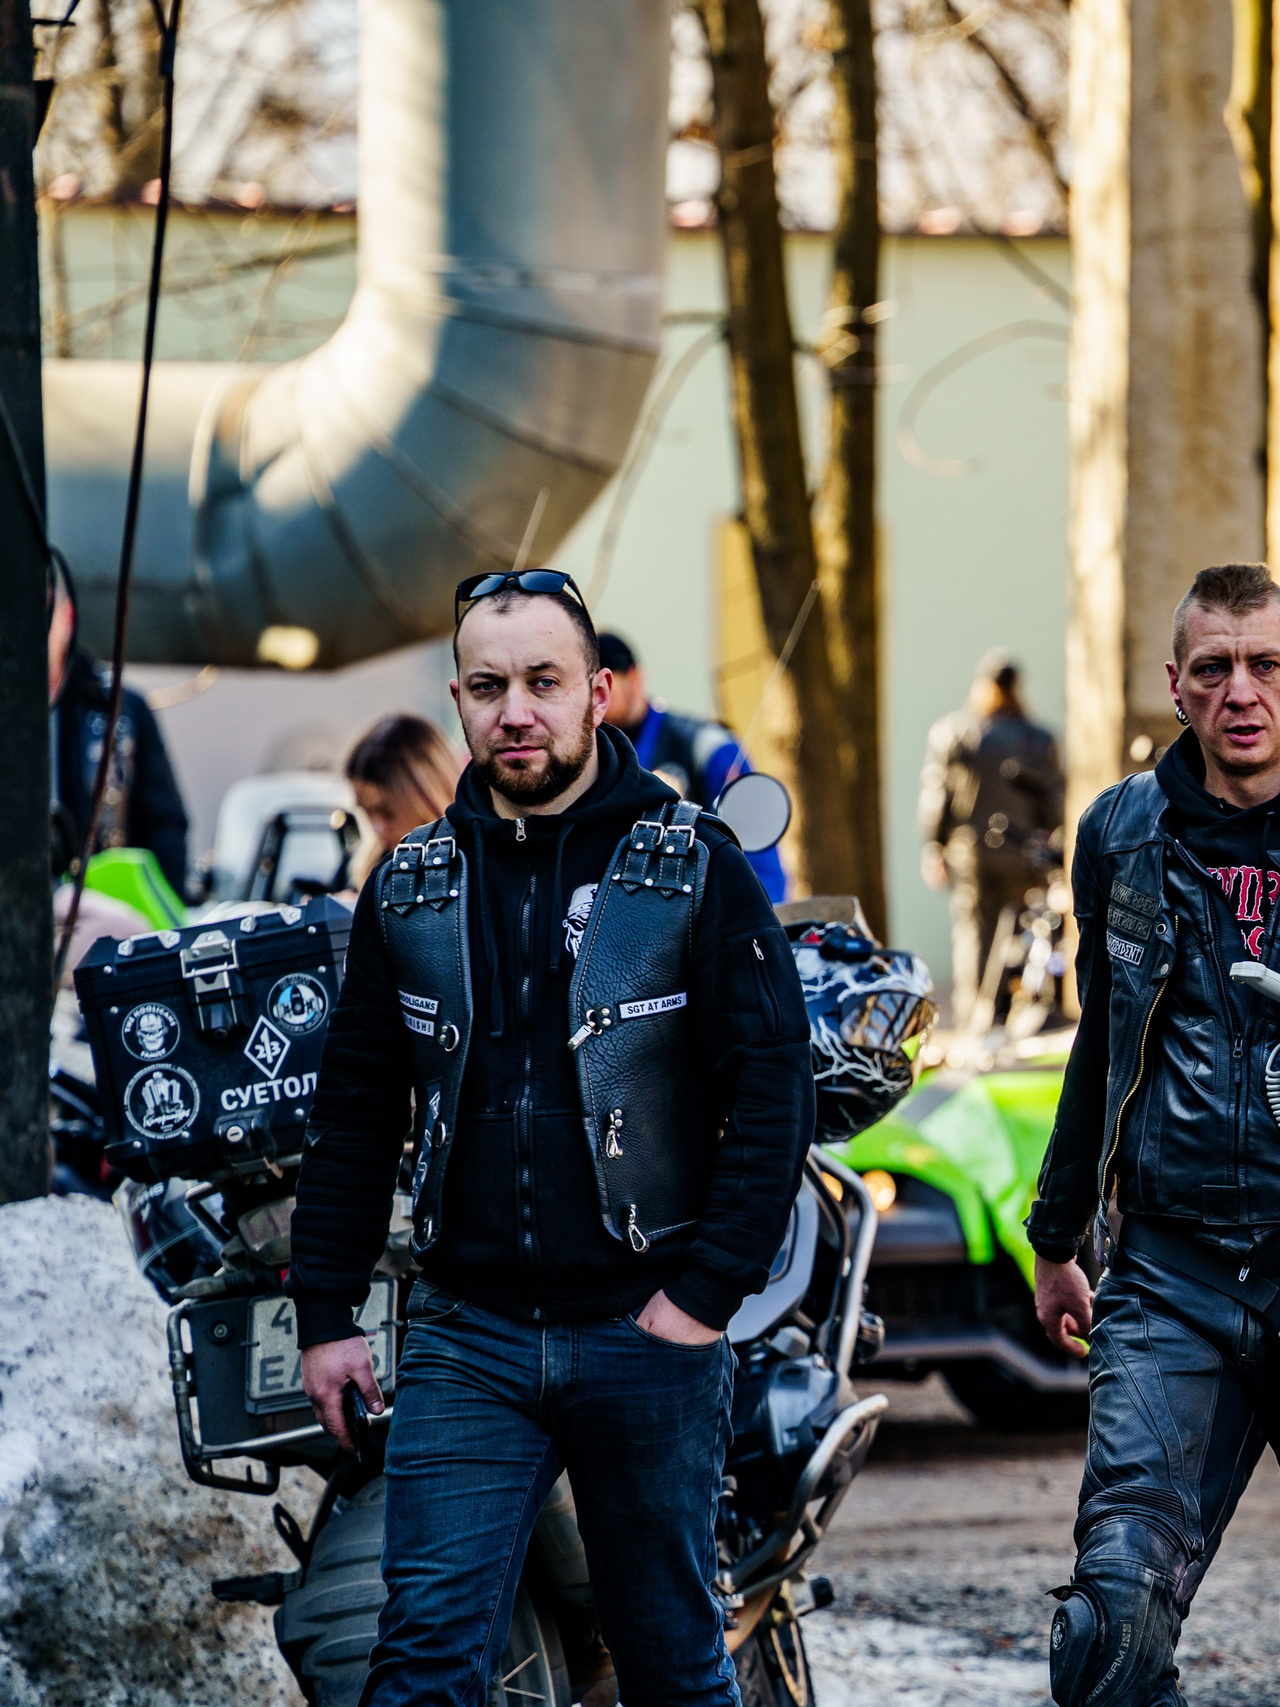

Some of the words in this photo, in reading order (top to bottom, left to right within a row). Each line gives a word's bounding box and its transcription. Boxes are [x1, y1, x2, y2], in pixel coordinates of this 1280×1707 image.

[627, 1003, 645, 1015] SGT
[648, 1001, 659, 1011] AT
[661, 996, 682, 1009] ARMS
